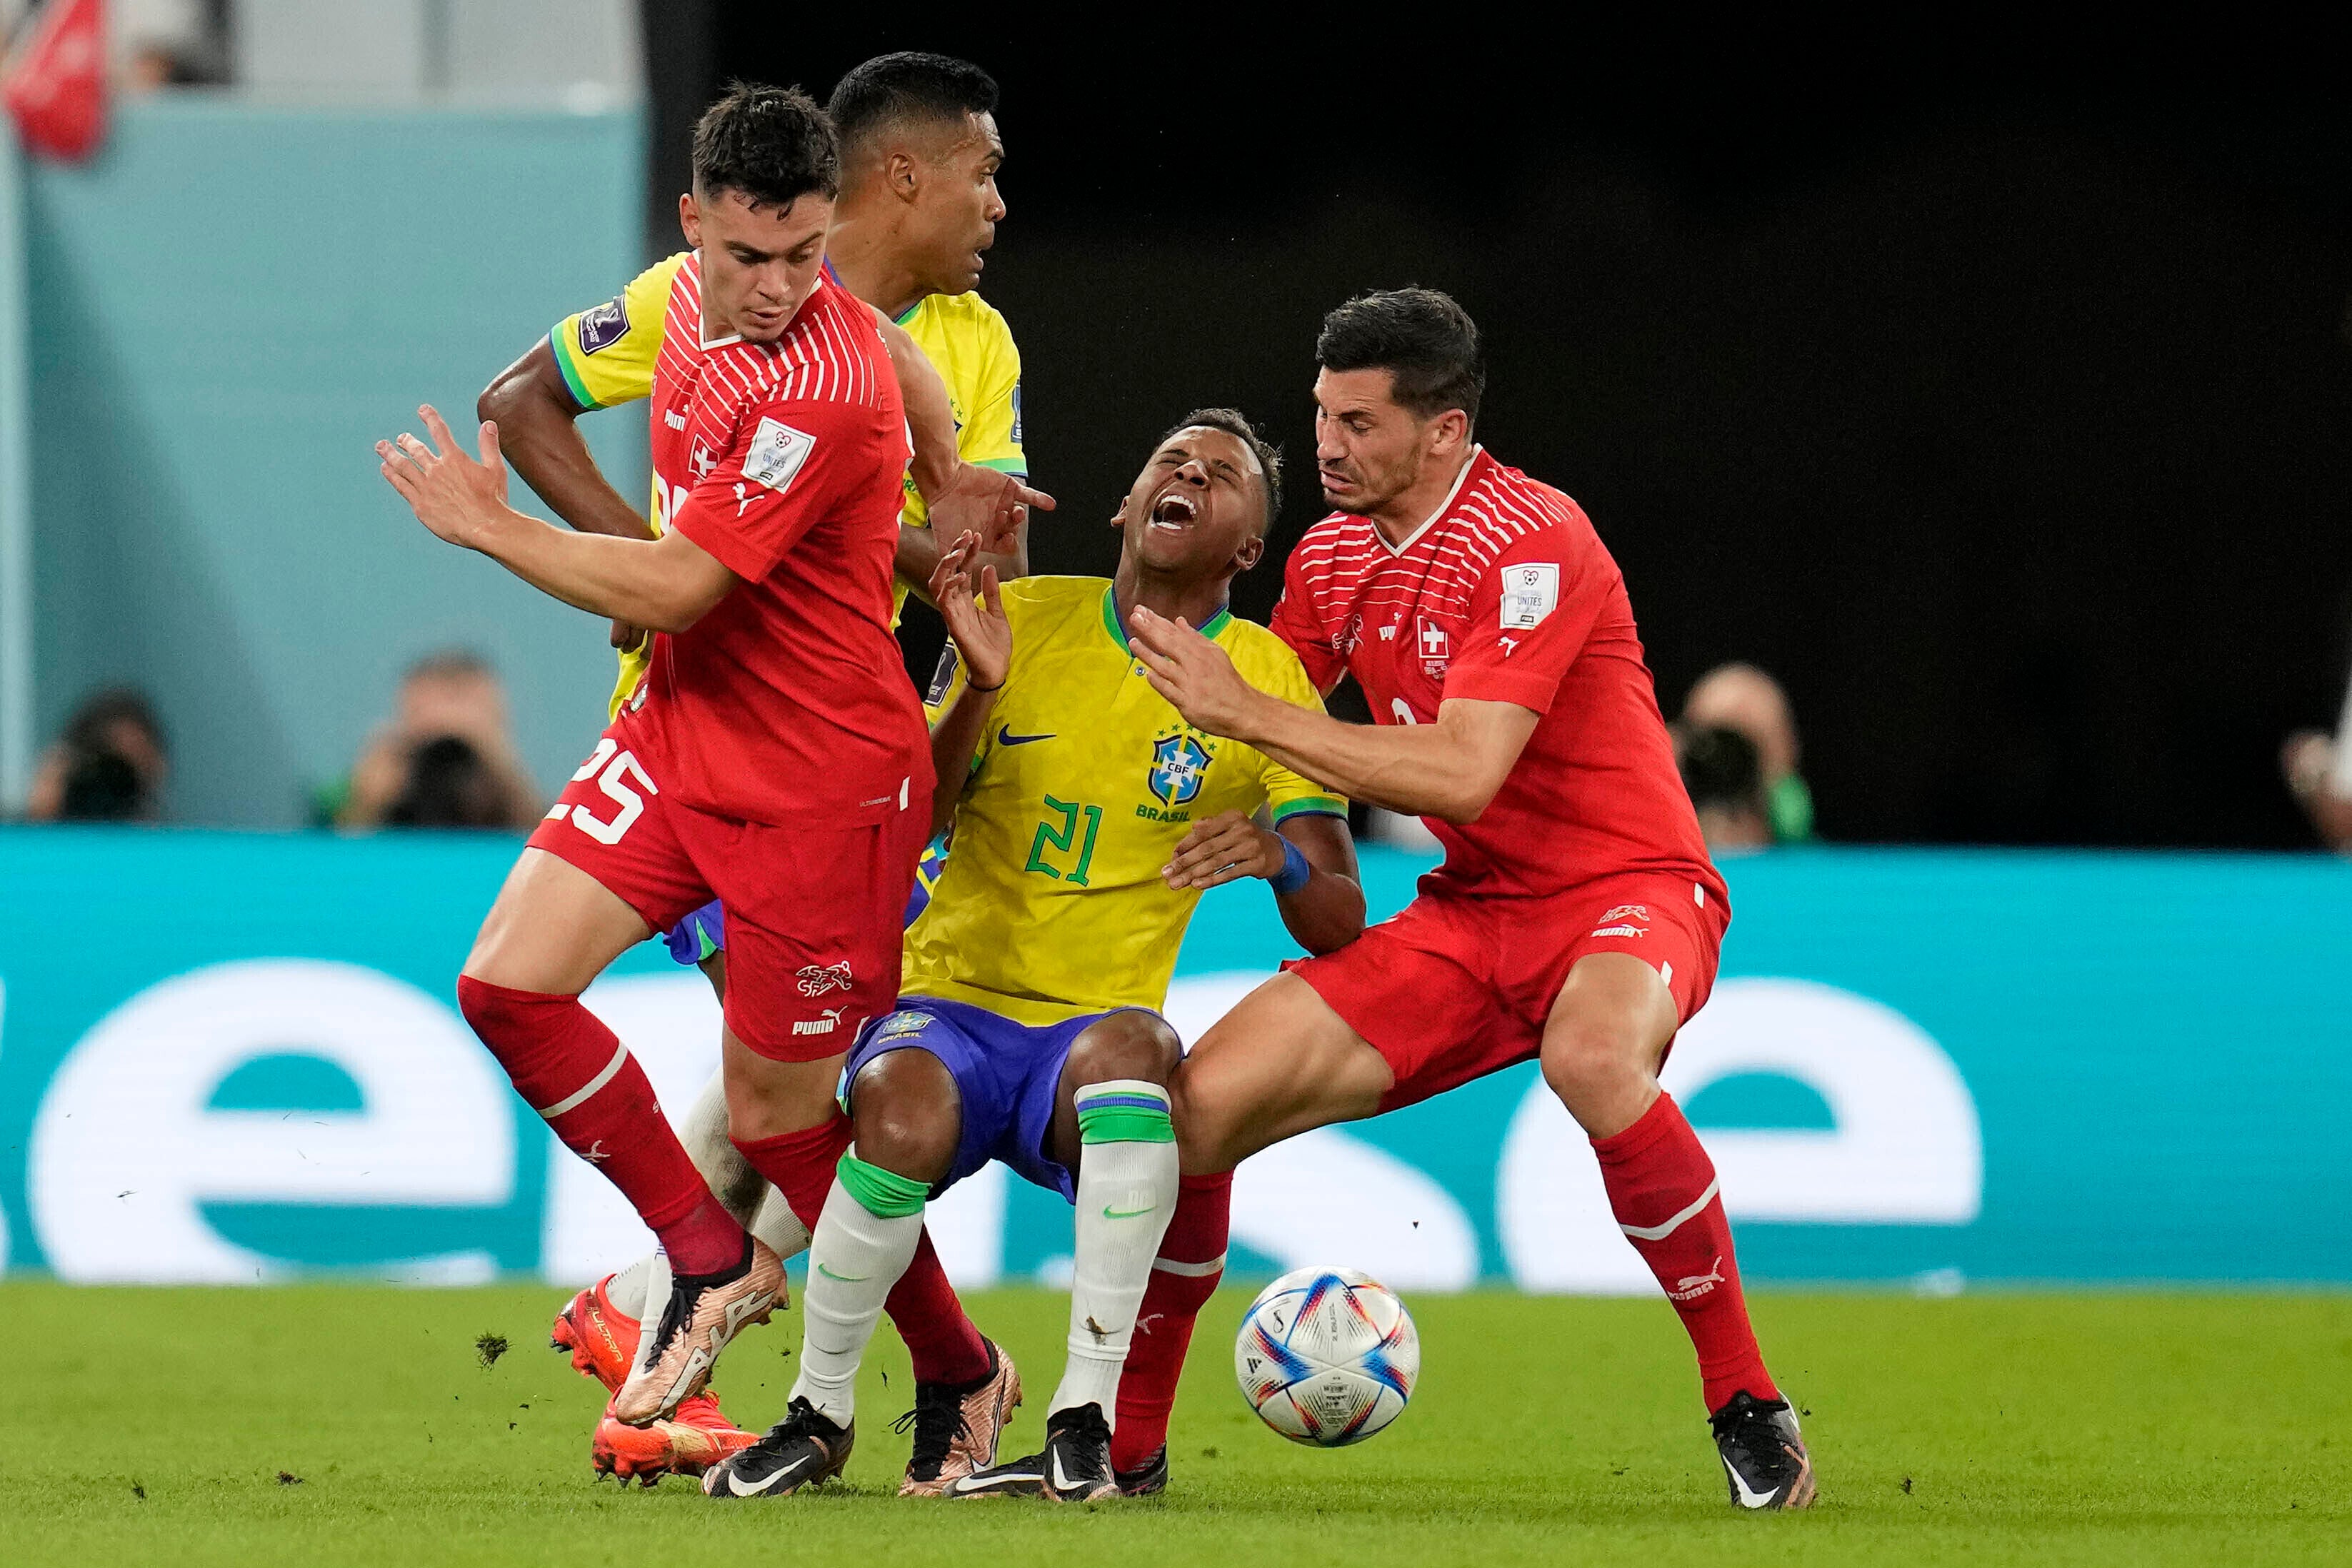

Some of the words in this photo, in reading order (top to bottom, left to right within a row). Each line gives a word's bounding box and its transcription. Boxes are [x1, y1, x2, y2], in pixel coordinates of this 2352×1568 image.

[664, 408, 686, 431] PUM
[1517, 595, 1543, 607] UNITES
[1167, 763, 1189, 775] CBF
[544, 738, 659, 845] 25
[1136, 803, 1191, 823] BRASIL
[1024, 793, 1103, 887] 21
[1591, 926, 1635, 938] PUMA
[792, 1018, 834, 1035] PUMA
[591, 1308, 624, 1363] ULTRA
